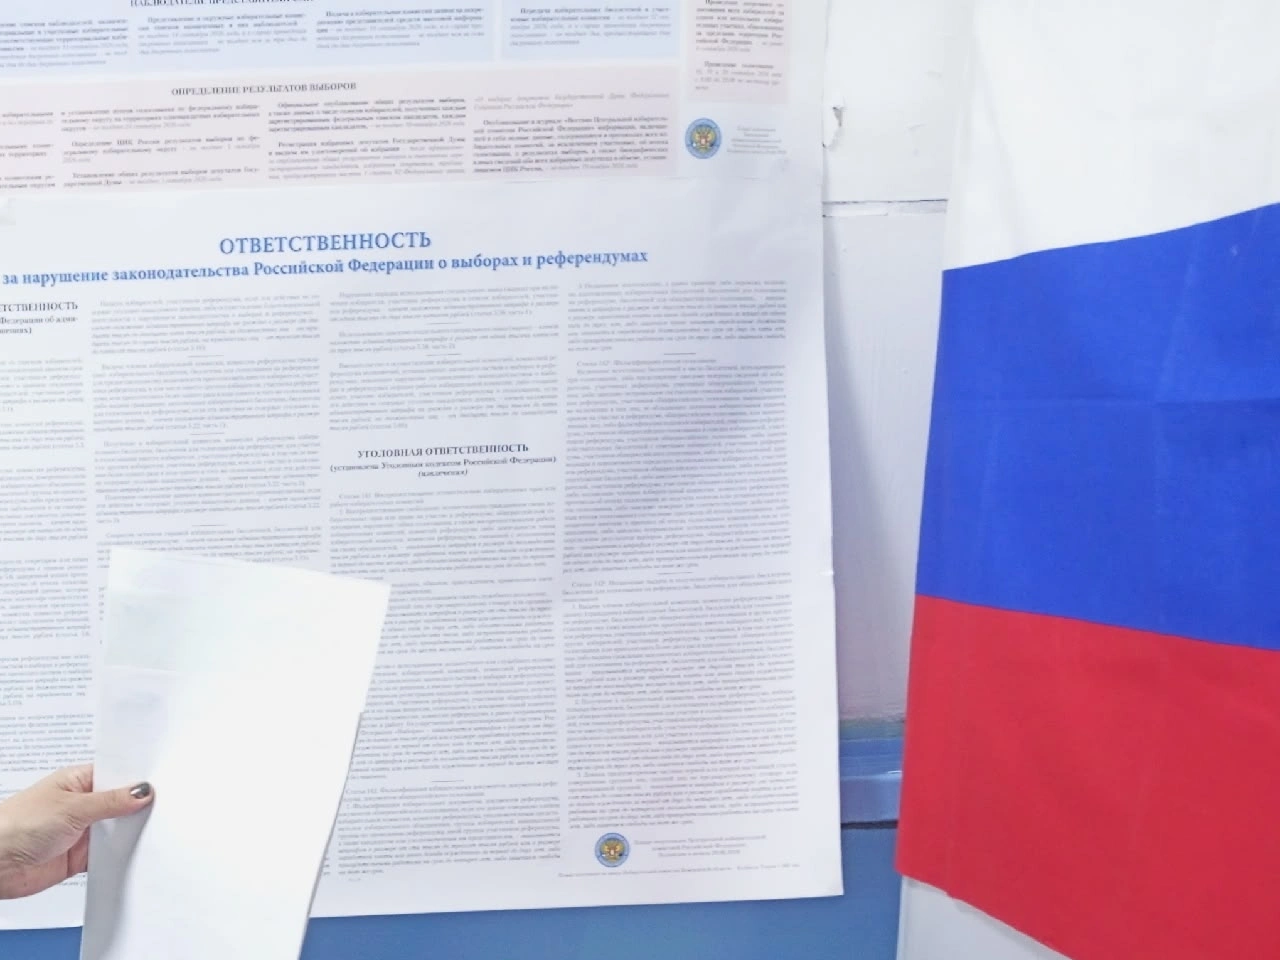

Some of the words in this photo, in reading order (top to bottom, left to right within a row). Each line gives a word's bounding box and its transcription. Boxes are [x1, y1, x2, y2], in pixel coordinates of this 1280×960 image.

[171, 87, 240, 97] ОПРЕДЕЛЕНИЕ
[242, 84, 308, 95] РЕЗУЛЬТАТОВ
[309, 82, 357, 92] ВЫБОРОВ
[219, 230, 432, 255] ОТВЕТСТВЕННОСТЬ
[2, 273, 19, 285] за
[23, 268, 109, 287] нарушение
[112, 262, 249, 281] законодательства
[254, 259, 344, 277] Российской
[348, 256, 434, 276] Федерации
[438, 258, 448, 270] о
[451, 253, 519, 269] выборах
[522, 254, 532, 266] и
[536, 250, 649, 270] референдумах
[357, 447, 423, 459] УГОЛОВНАЯ
[425, 443, 529, 456] ОТВЕТСТВЕННОСТЬ
